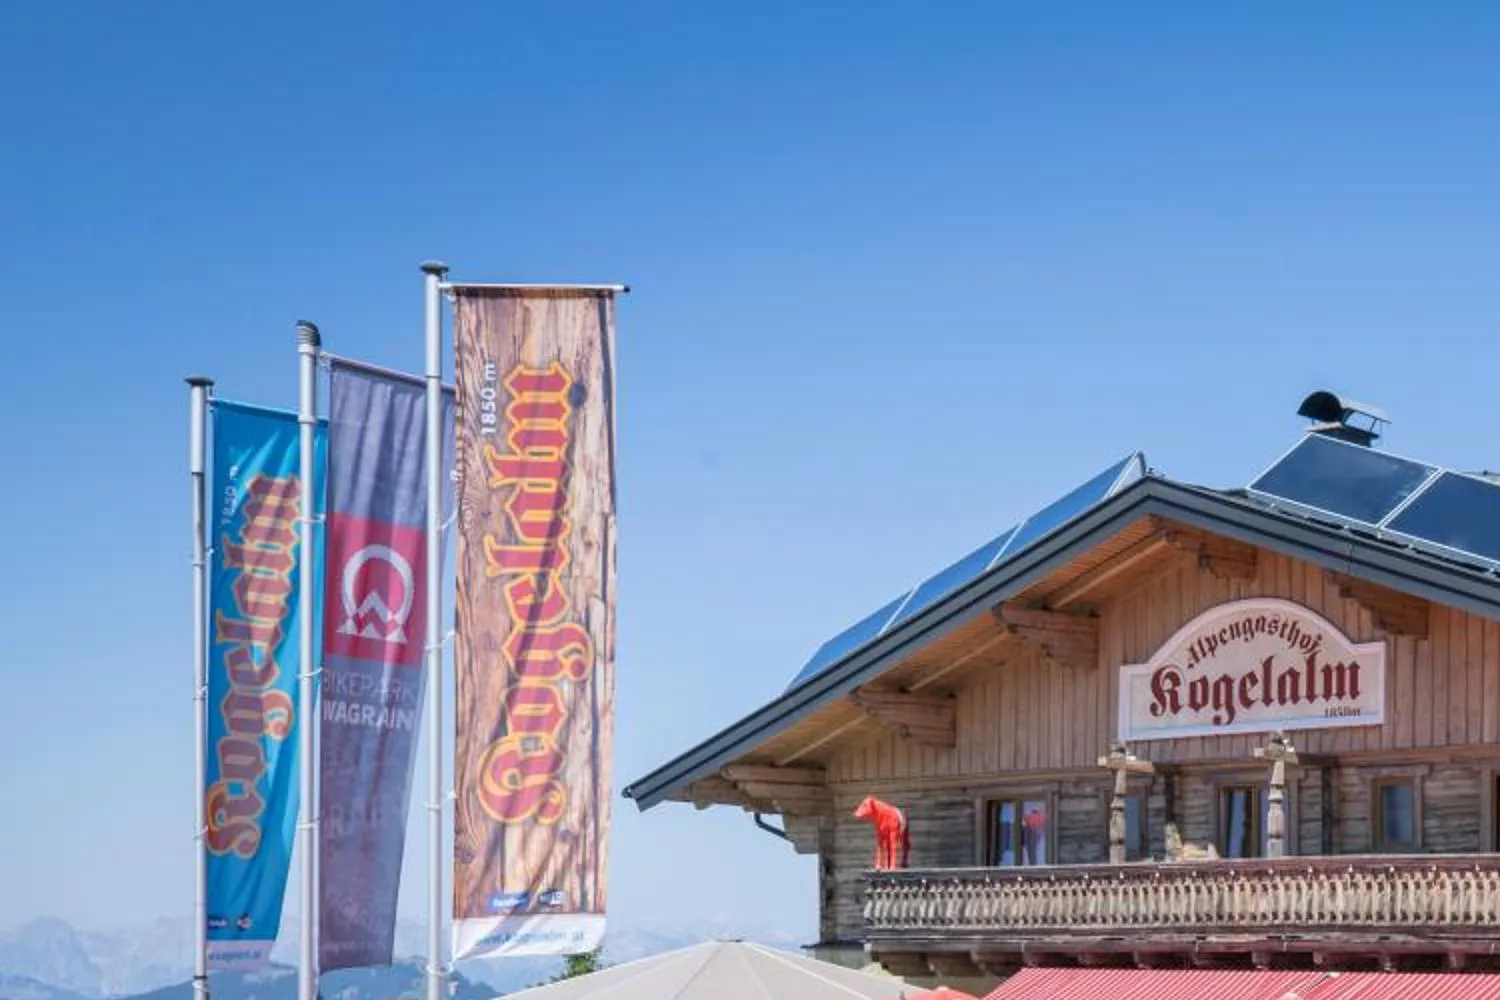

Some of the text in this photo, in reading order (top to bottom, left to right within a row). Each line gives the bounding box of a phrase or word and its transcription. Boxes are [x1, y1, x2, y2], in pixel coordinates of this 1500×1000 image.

[480, 361, 497, 435] 1850 m
[204, 474, 302, 859] Kogelalm
[476, 360, 593, 826] Kogelalm
[1150, 652, 1361, 725] Kogelalm
